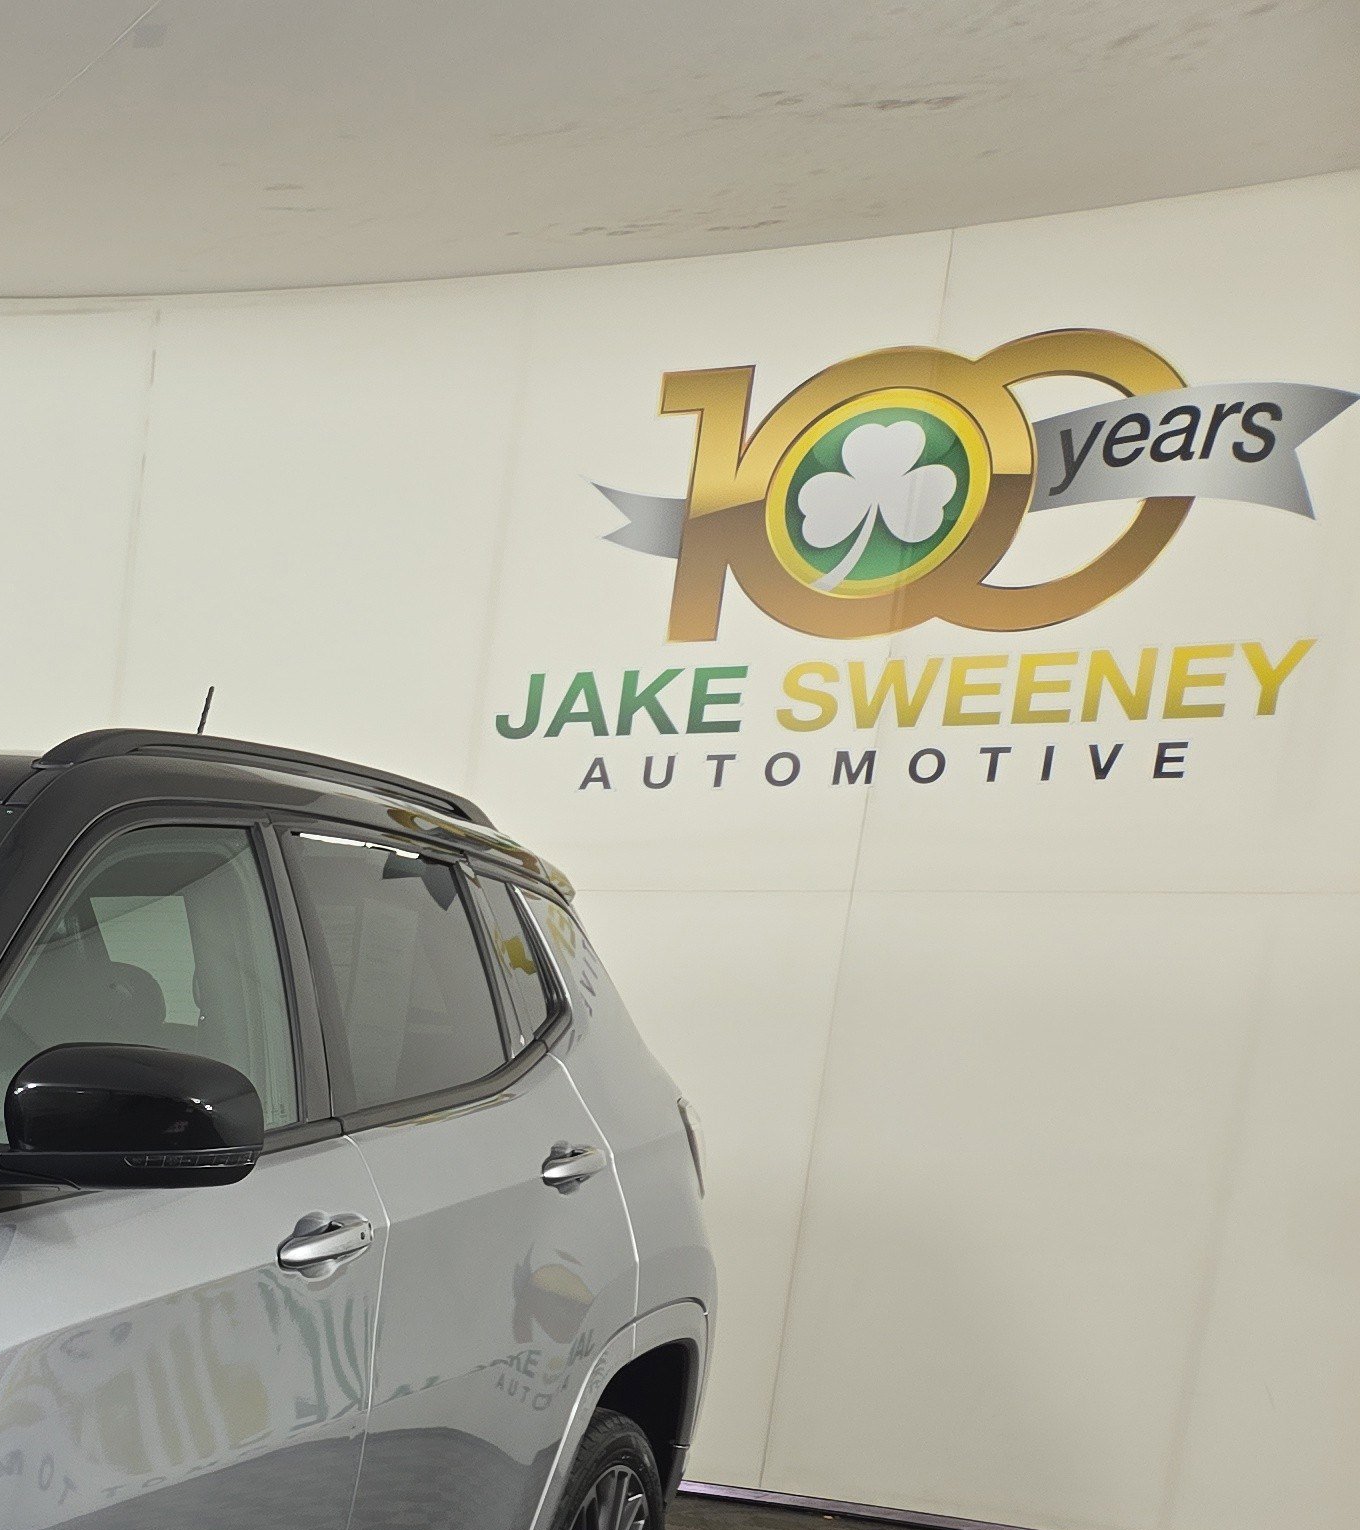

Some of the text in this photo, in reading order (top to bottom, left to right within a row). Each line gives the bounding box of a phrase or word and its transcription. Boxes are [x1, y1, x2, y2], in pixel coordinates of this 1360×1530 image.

[660, 328, 1283, 643] 100 years
[495, 639, 1317, 739] JAKE SWEENEY
[580, 741, 1189, 790] AUTOMOTIVE
